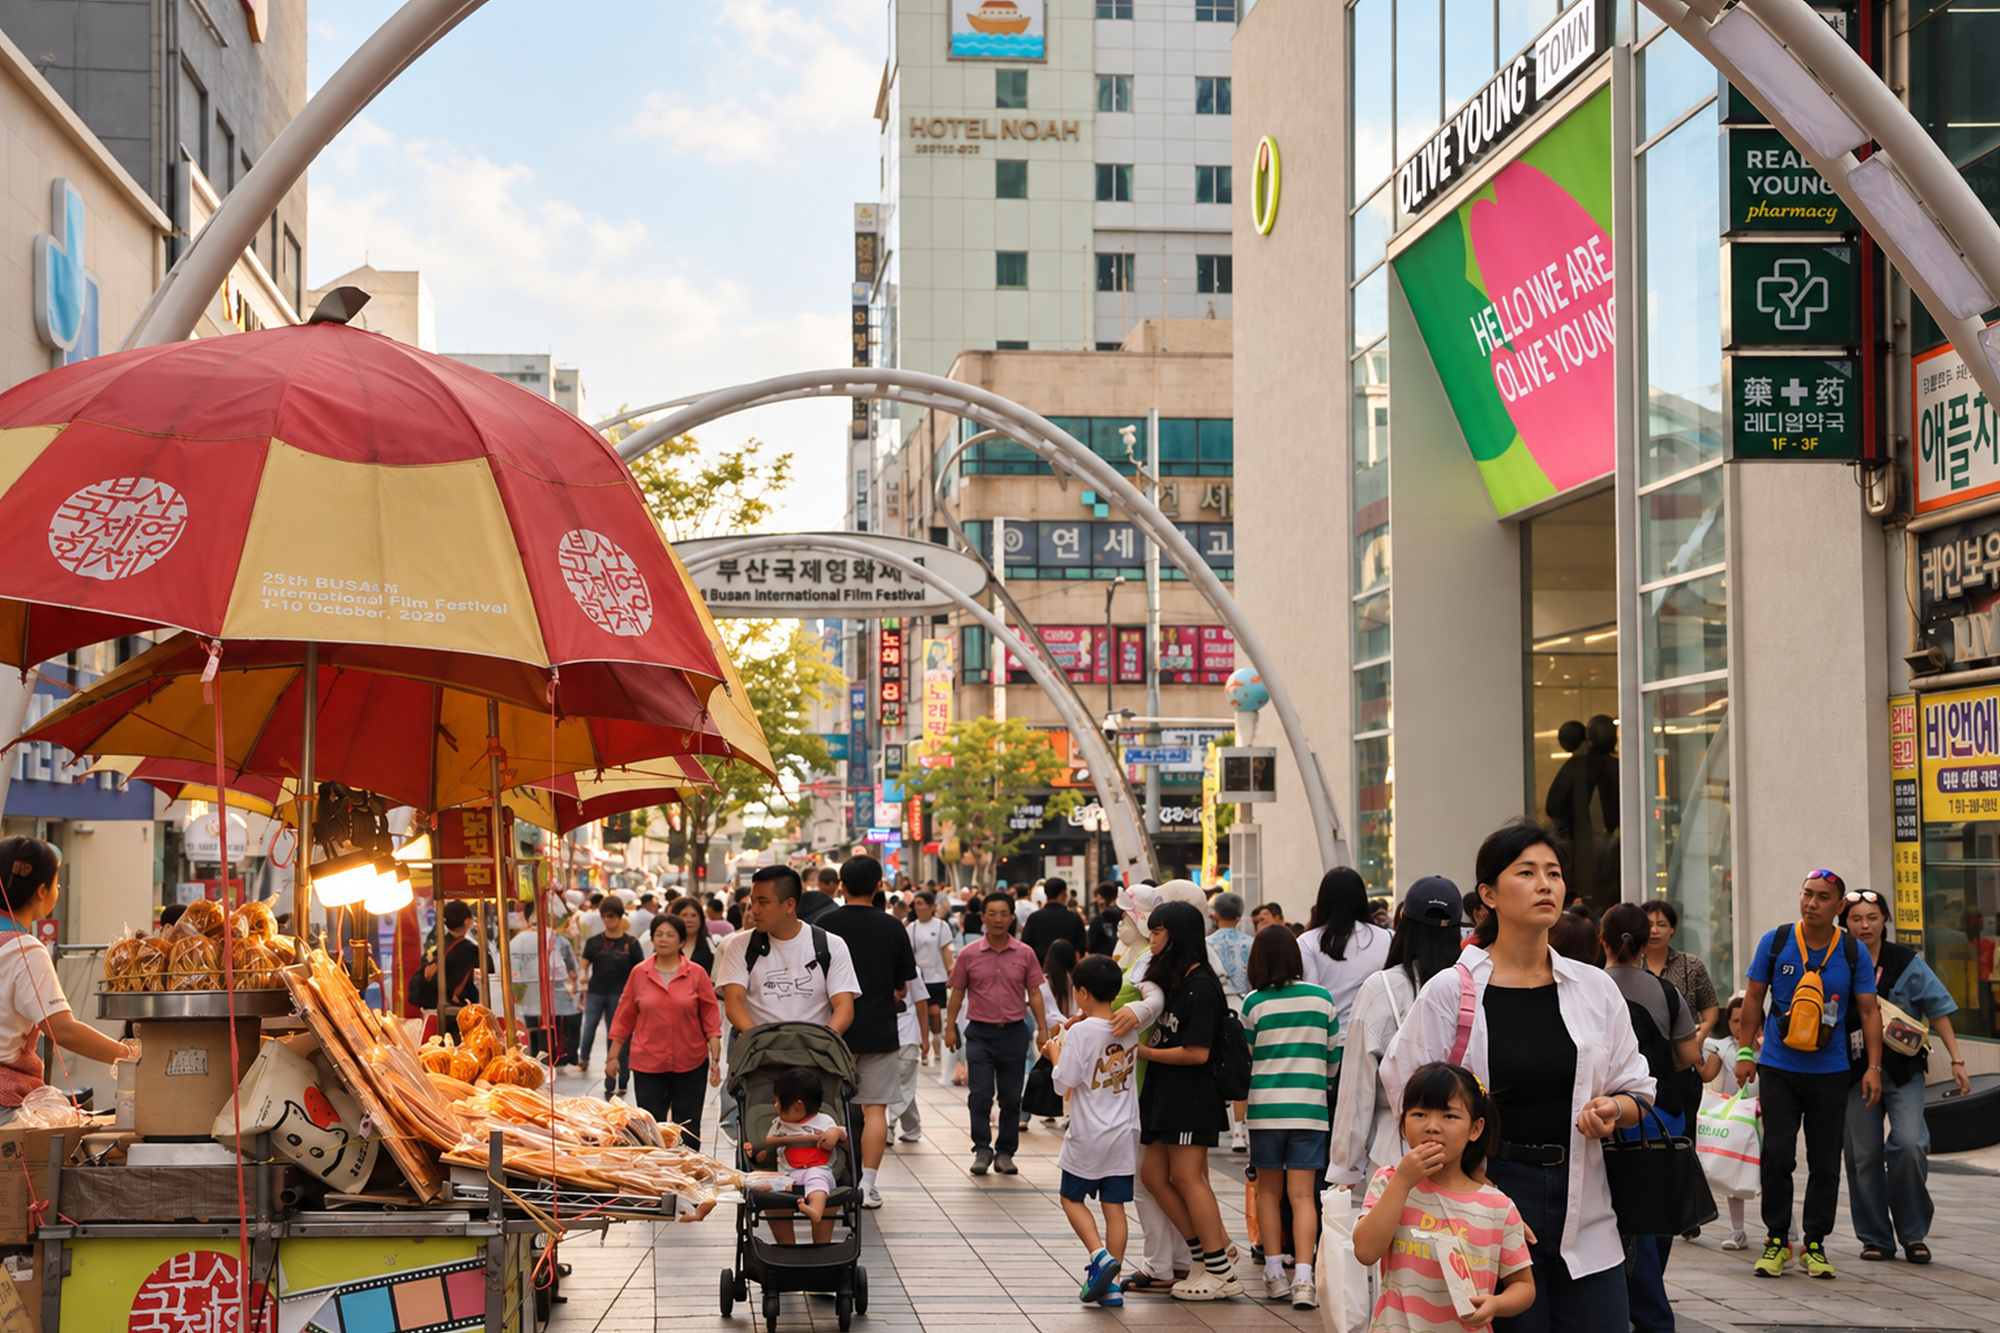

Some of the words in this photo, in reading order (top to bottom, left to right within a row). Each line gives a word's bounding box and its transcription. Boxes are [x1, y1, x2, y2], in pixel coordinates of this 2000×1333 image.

[1400, 126, 1451, 214] OLIVE
[1456, 55, 1526, 166] YOUNG
[1539, 5, 1590, 84] TOWN
[909, 117, 997, 139] HOTEL
[1001, 119, 1080, 142] NOAH
[1745, 200, 1838, 224] pharmacy
[1469, 286, 1534, 357] HELLO
[1526, 262, 1570, 319] WE
[1565, 234, 1613, 300] ARE
[1496, 339, 1556, 402] OLIVE
[1744, 377, 1773, 407] 藥
[1816, 377, 1845, 407] 药
[1771, 437, 1788, 451] 1F
[1801, 437, 1819, 451] 3F
[390, 595, 429, 610] Film
[435, 598, 508, 614] Festival
[711, 588, 751, 602] Busan
[755, 588, 840, 602] International
[844, 588, 873, 602] Film
[876, 588, 925, 602] Festival
[262, 599, 303, 613] 1-10
[399, 609, 446, 623] 2020
